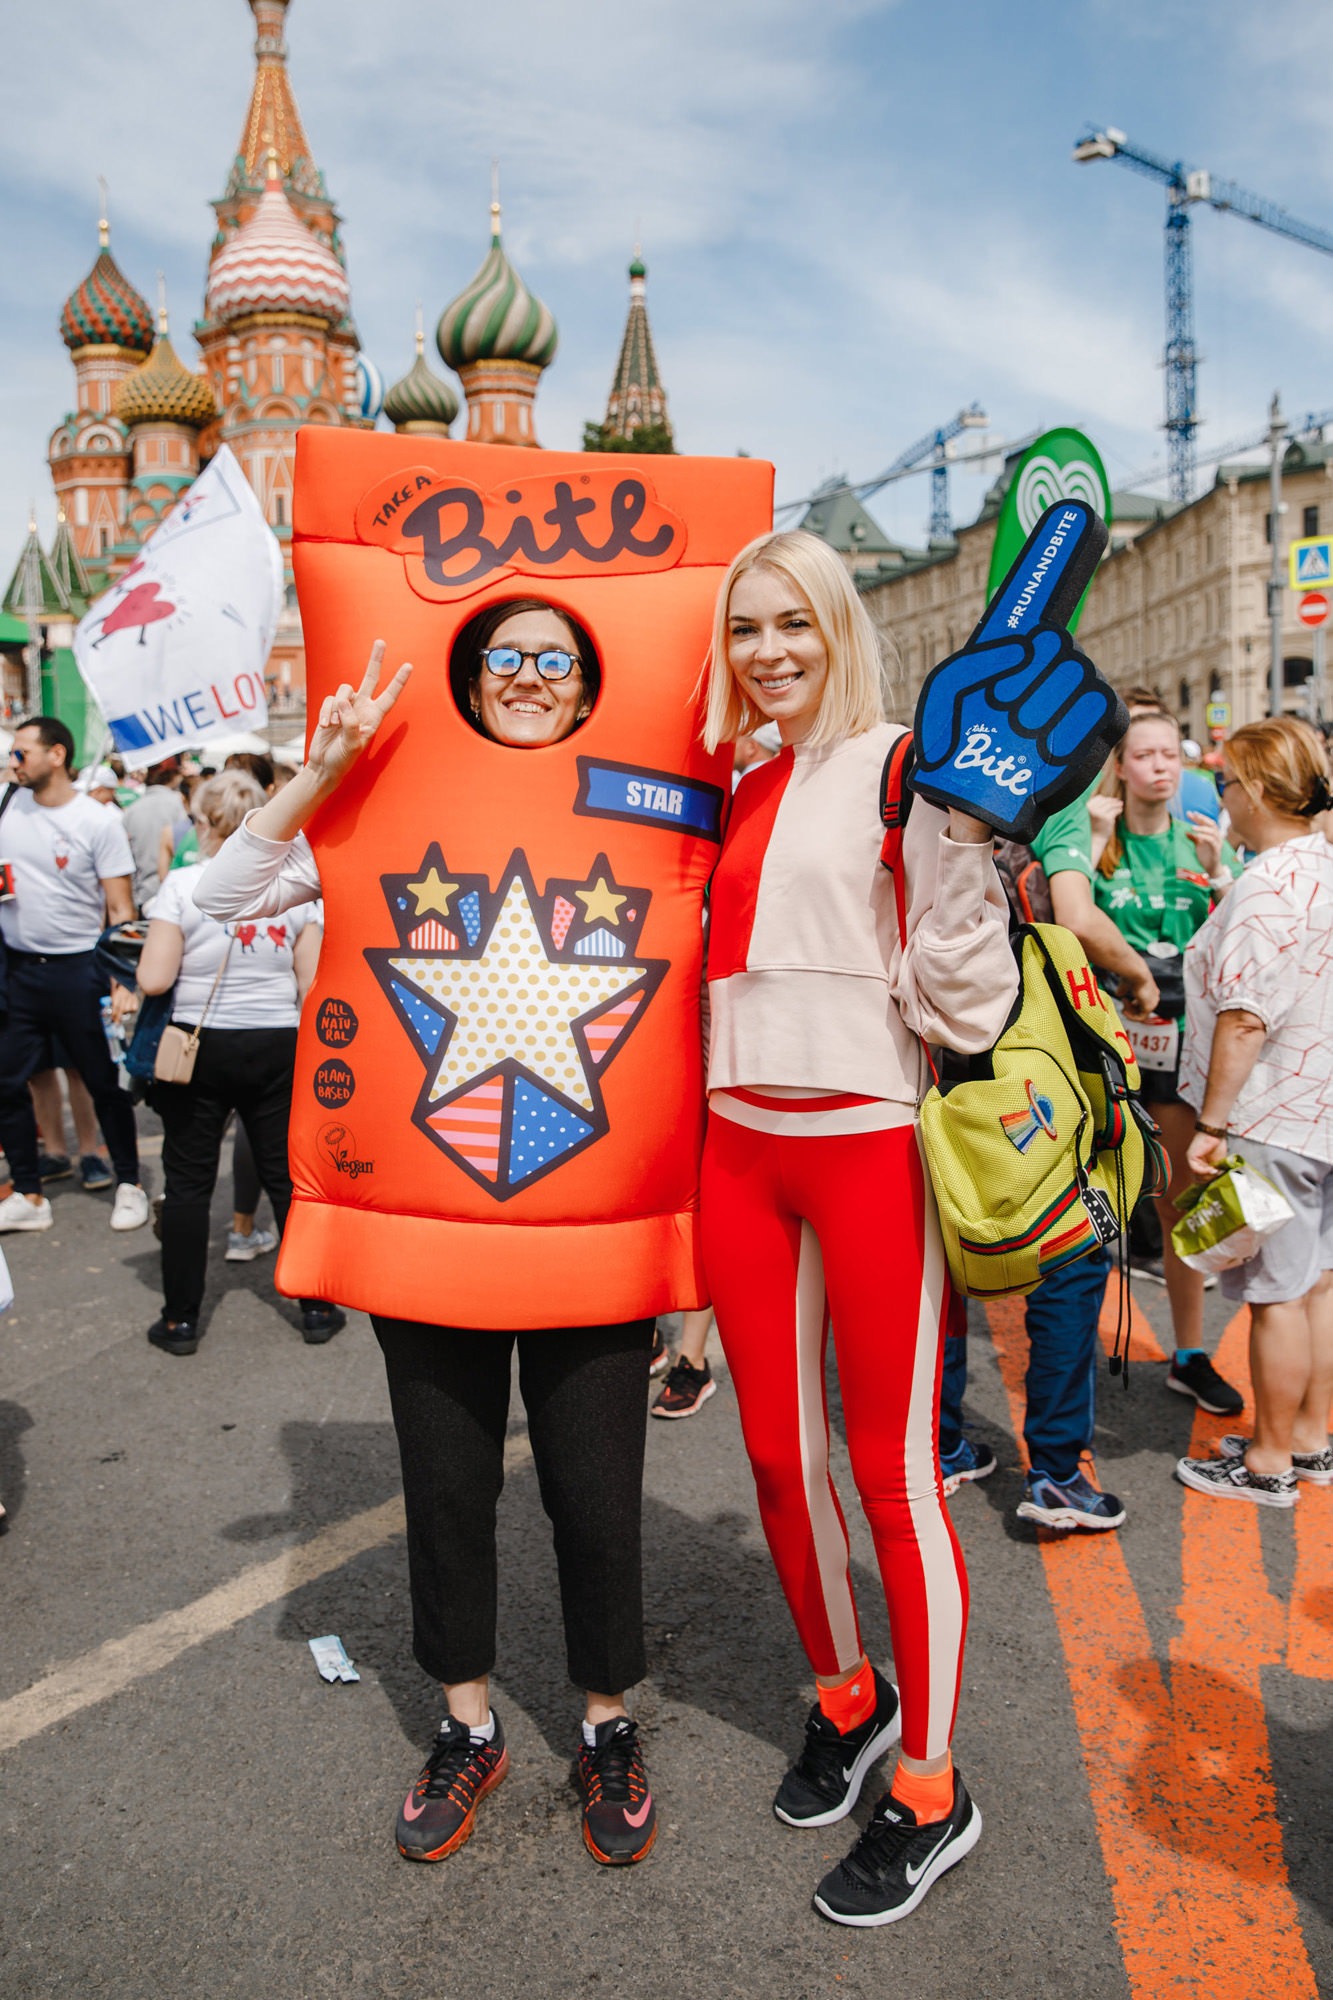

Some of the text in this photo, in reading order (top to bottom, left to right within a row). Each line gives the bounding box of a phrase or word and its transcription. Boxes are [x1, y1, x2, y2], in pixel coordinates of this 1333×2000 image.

[372, 475, 432, 526] TAKE A
[1007, 511, 1078, 629] #RUNANDBITE
[143, 691, 215, 741] WE
[971, 723, 990, 733] take
[626, 781, 684, 816] STAR
[1066, 967, 1109, 1014] H
[325, 1001, 348, 1016] ALL
[325, 1028, 350, 1042] RAL
[317, 1068, 351, 1086] PLANT
[317, 1086, 351, 1101] BASED
[328, 1150, 374, 1179] Vegan
